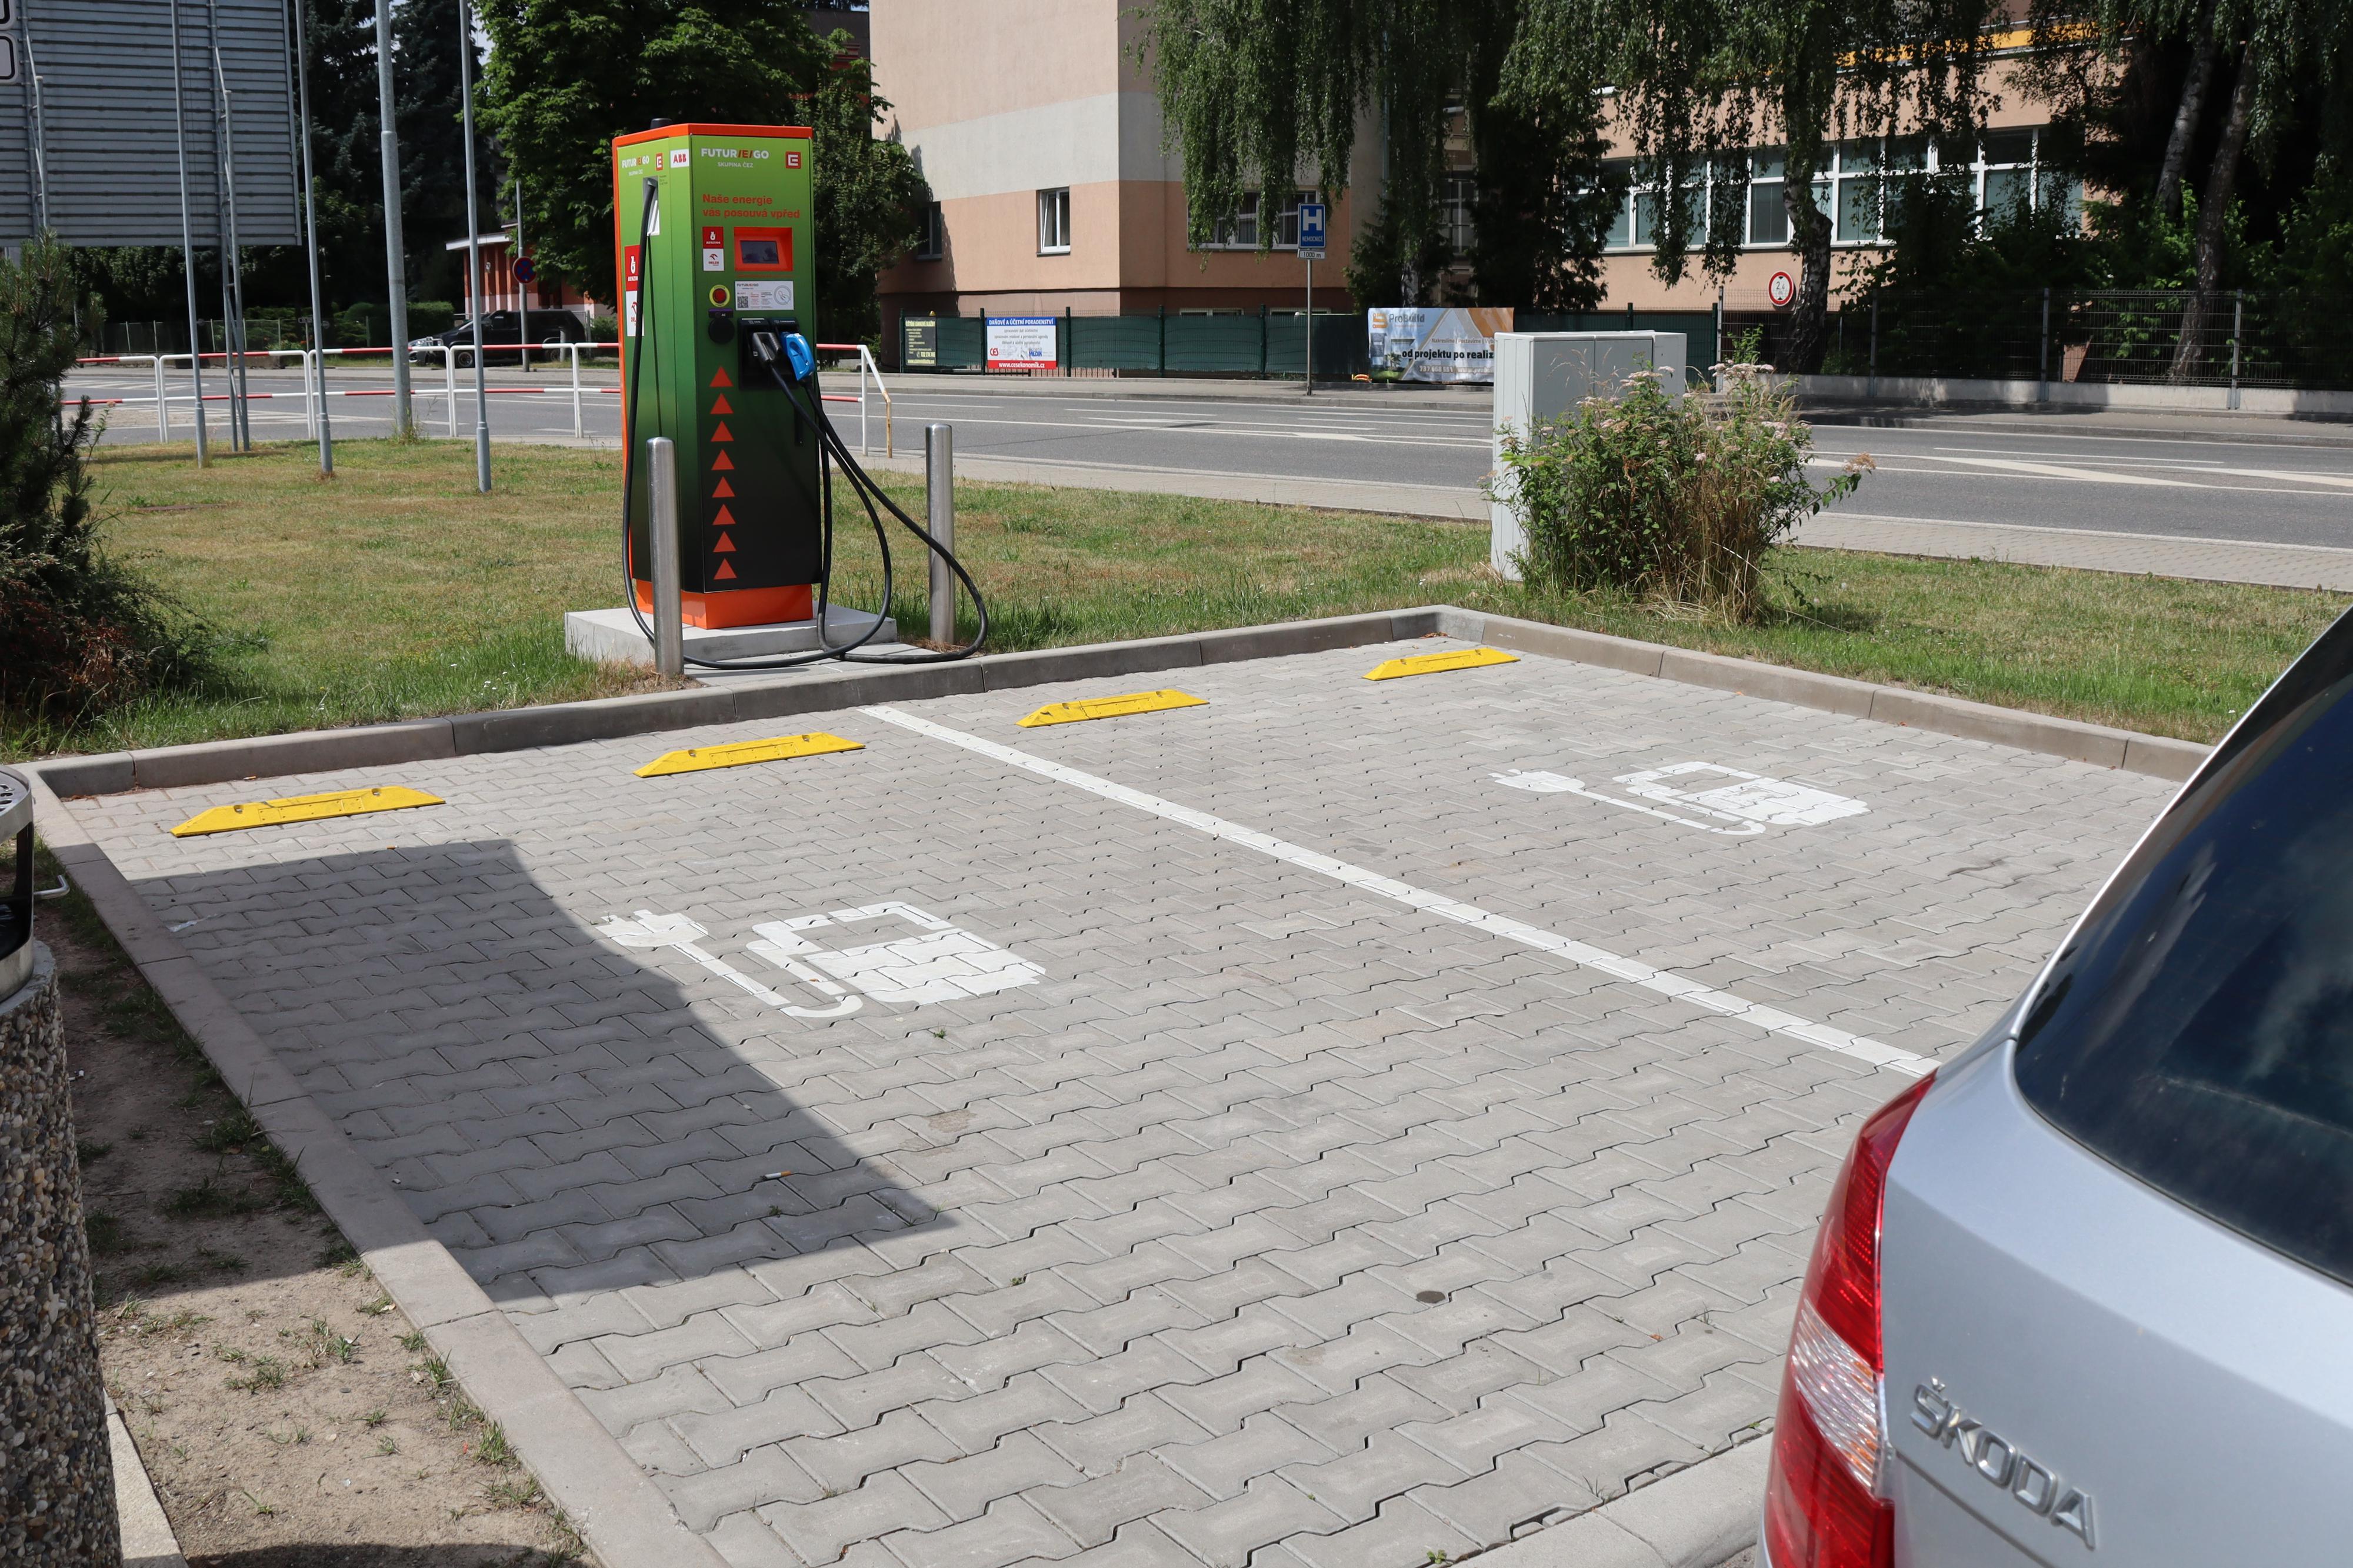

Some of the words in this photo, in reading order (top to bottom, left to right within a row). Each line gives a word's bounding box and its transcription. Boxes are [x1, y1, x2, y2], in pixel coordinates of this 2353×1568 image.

[673, 154, 686, 164] ABB
[701, 148, 769, 159] FUTUR/E/GO
[702, 194, 729, 203] Naše
[732, 195, 772, 206] energie
[702, 208, 721, 217] vás
[724, 208, 768, 219] posouvá
[771, 208, 801, 219] vpřed
[1303, 209, 1322, 231] H
[1389, 313, 1425, 322] ProBuild
[990, 348, 999, 356] CES
[1402, 349, 1412, 358] od
[1414, 349, 1451, 360] projektu
[1454, 352, 1465, 361] po
[1467, 350, 1494, 359] realiz
[1909, 1376, 2095, 1550] ŠKODA
